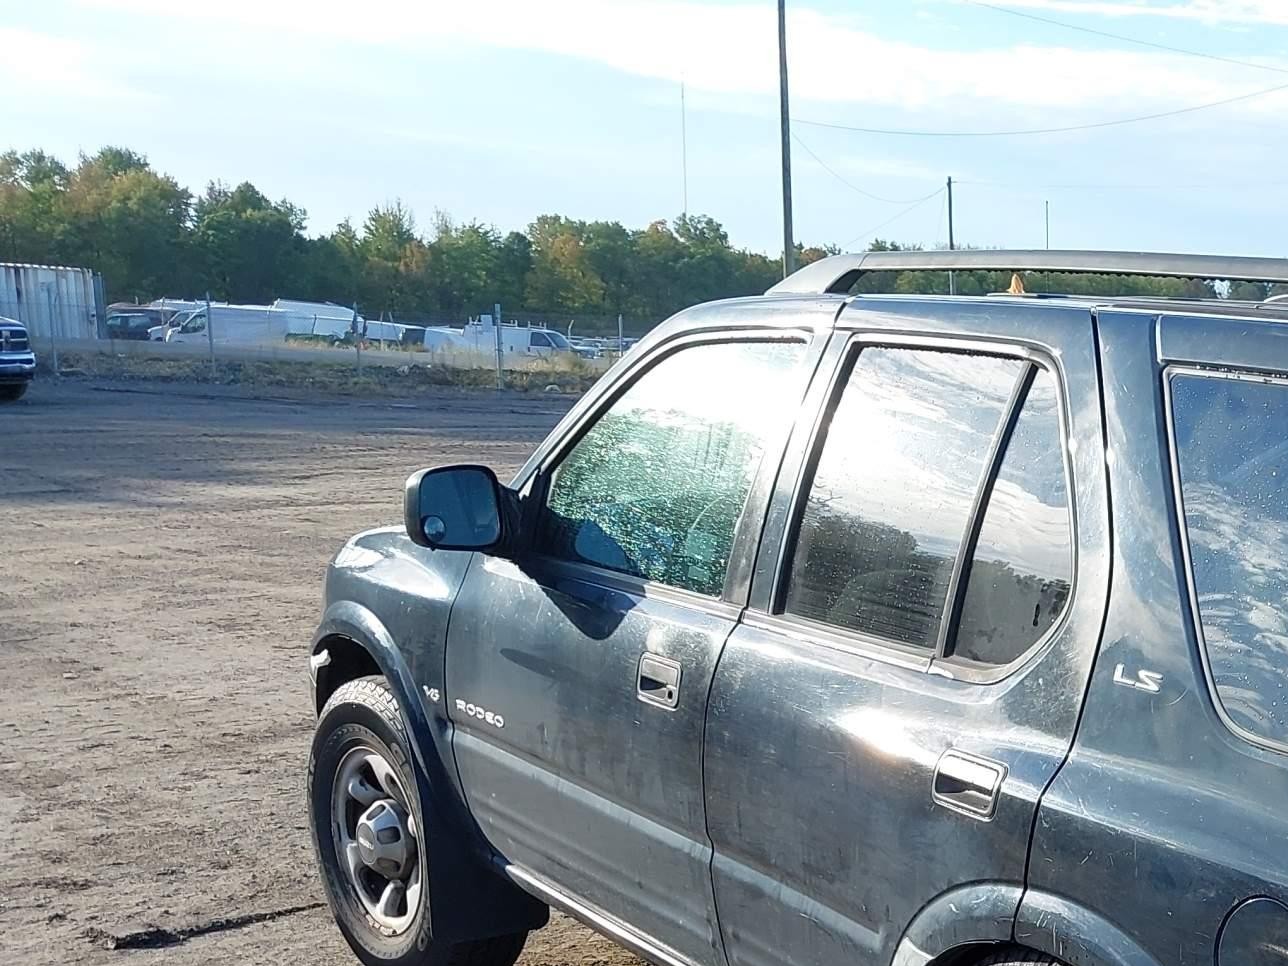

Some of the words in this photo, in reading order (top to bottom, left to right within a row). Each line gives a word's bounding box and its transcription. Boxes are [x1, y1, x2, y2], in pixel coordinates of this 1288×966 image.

[422, 684, 440, 702] V6
[1113, 663, 1164, 694] LS
[455, 698, 504, 728] RODEO
